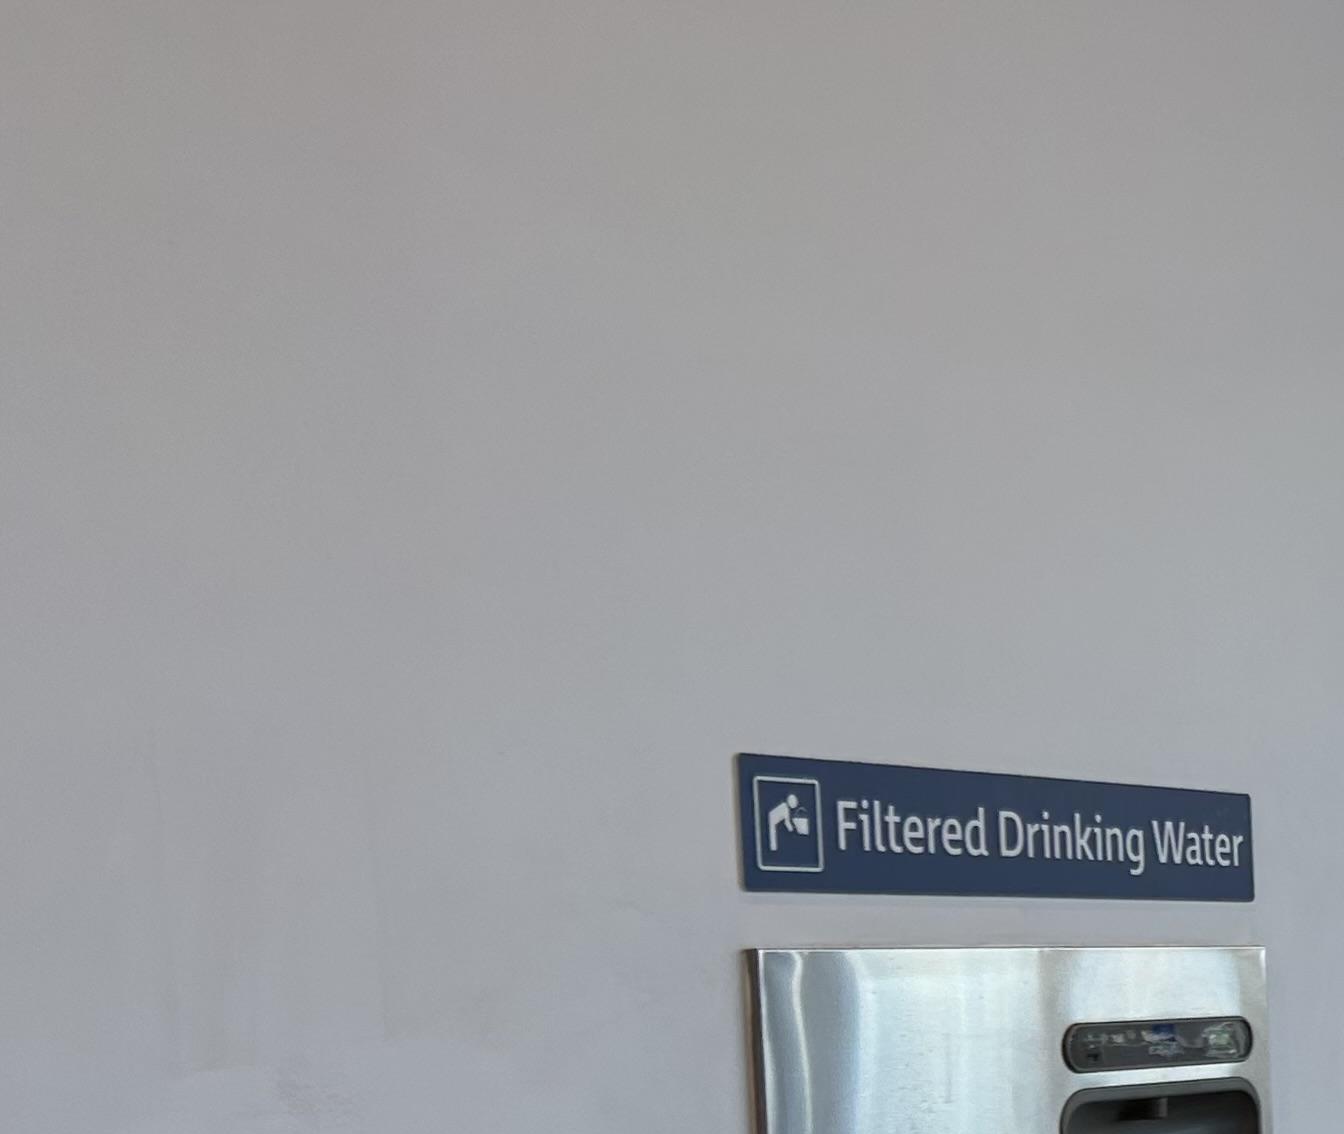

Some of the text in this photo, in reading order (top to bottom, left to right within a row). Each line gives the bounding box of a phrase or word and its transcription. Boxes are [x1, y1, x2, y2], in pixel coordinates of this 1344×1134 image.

[836, 799, 1244, 876] Filtered Drinking Water
